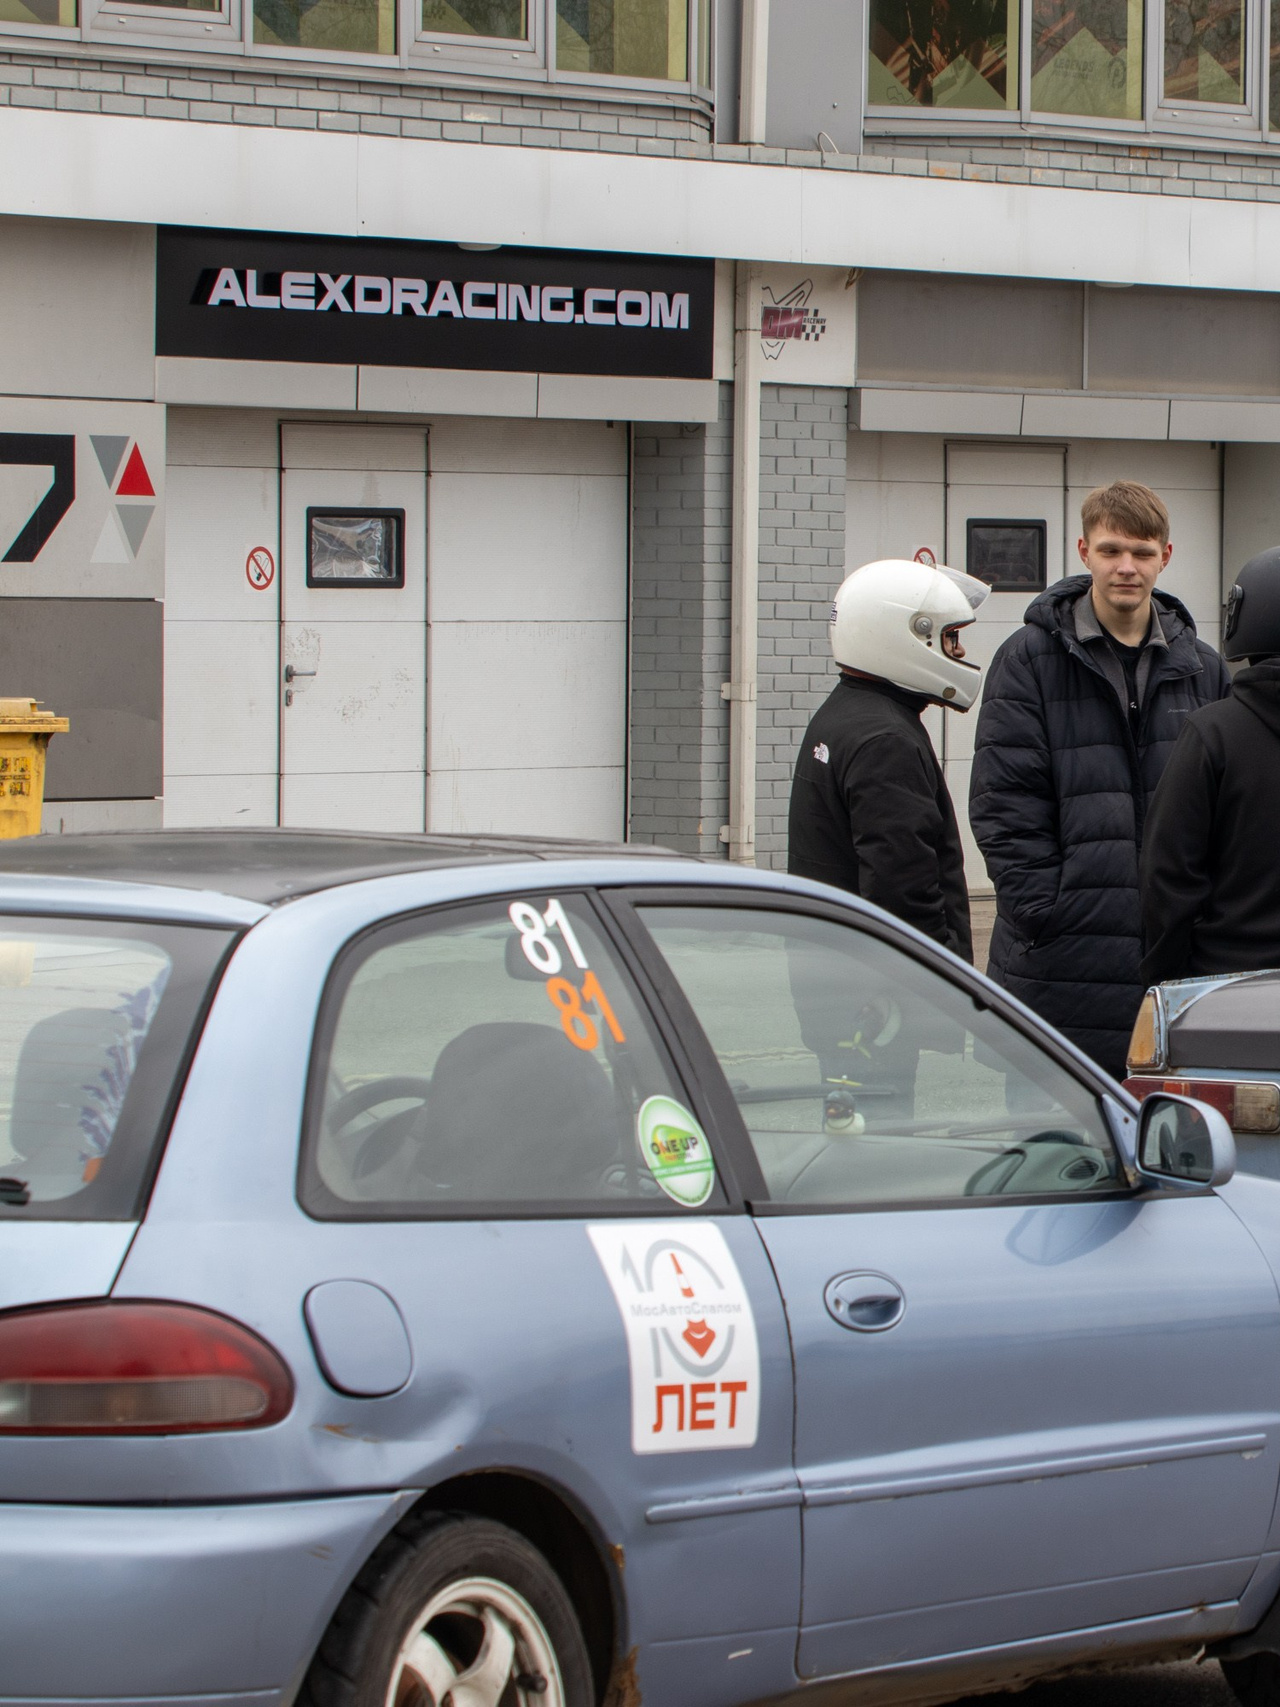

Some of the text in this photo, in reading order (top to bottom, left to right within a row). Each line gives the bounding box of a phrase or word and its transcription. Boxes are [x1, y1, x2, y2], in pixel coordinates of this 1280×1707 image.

[207, 267, 690, 330] ALEXDRACING.COM
[803, 317, 826, 325] RACEWAY
[508, 898, 589, 974] 81
[546, 970, 627, 1052] 81
[630, 1302, 742, 1317] МосАвтоСлалом
[652, 1381, 748, 1434] ЛЕТ
